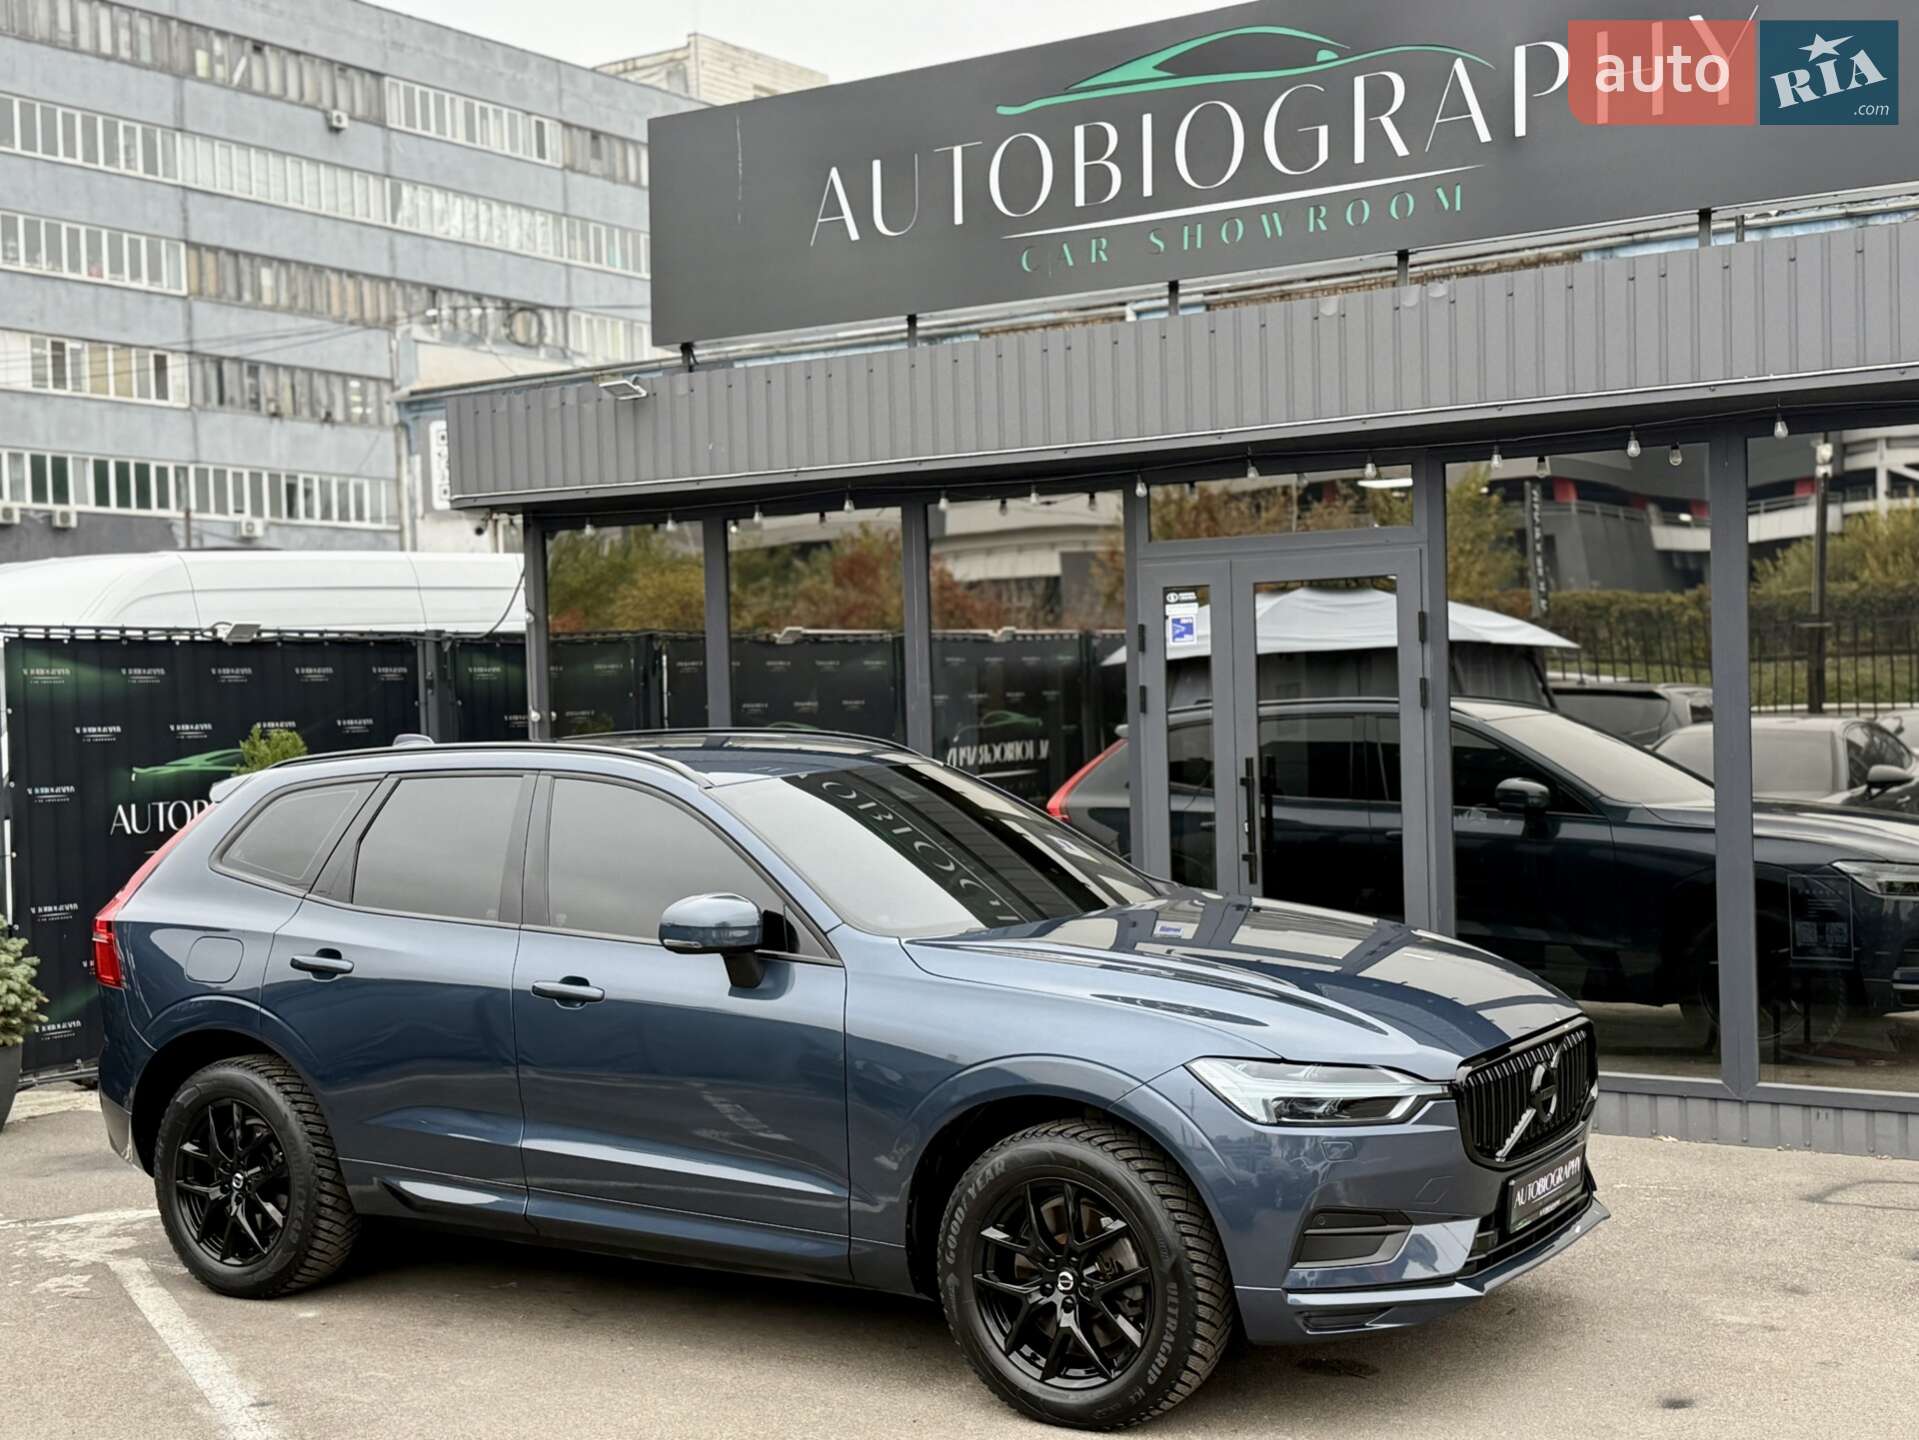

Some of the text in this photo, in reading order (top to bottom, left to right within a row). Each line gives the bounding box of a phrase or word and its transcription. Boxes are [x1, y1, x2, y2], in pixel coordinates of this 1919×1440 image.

[1020, 183, 1463, 273] CAR SHOWROOM
[1147, 1281, 1179, 1385] ULTRAGRIP
